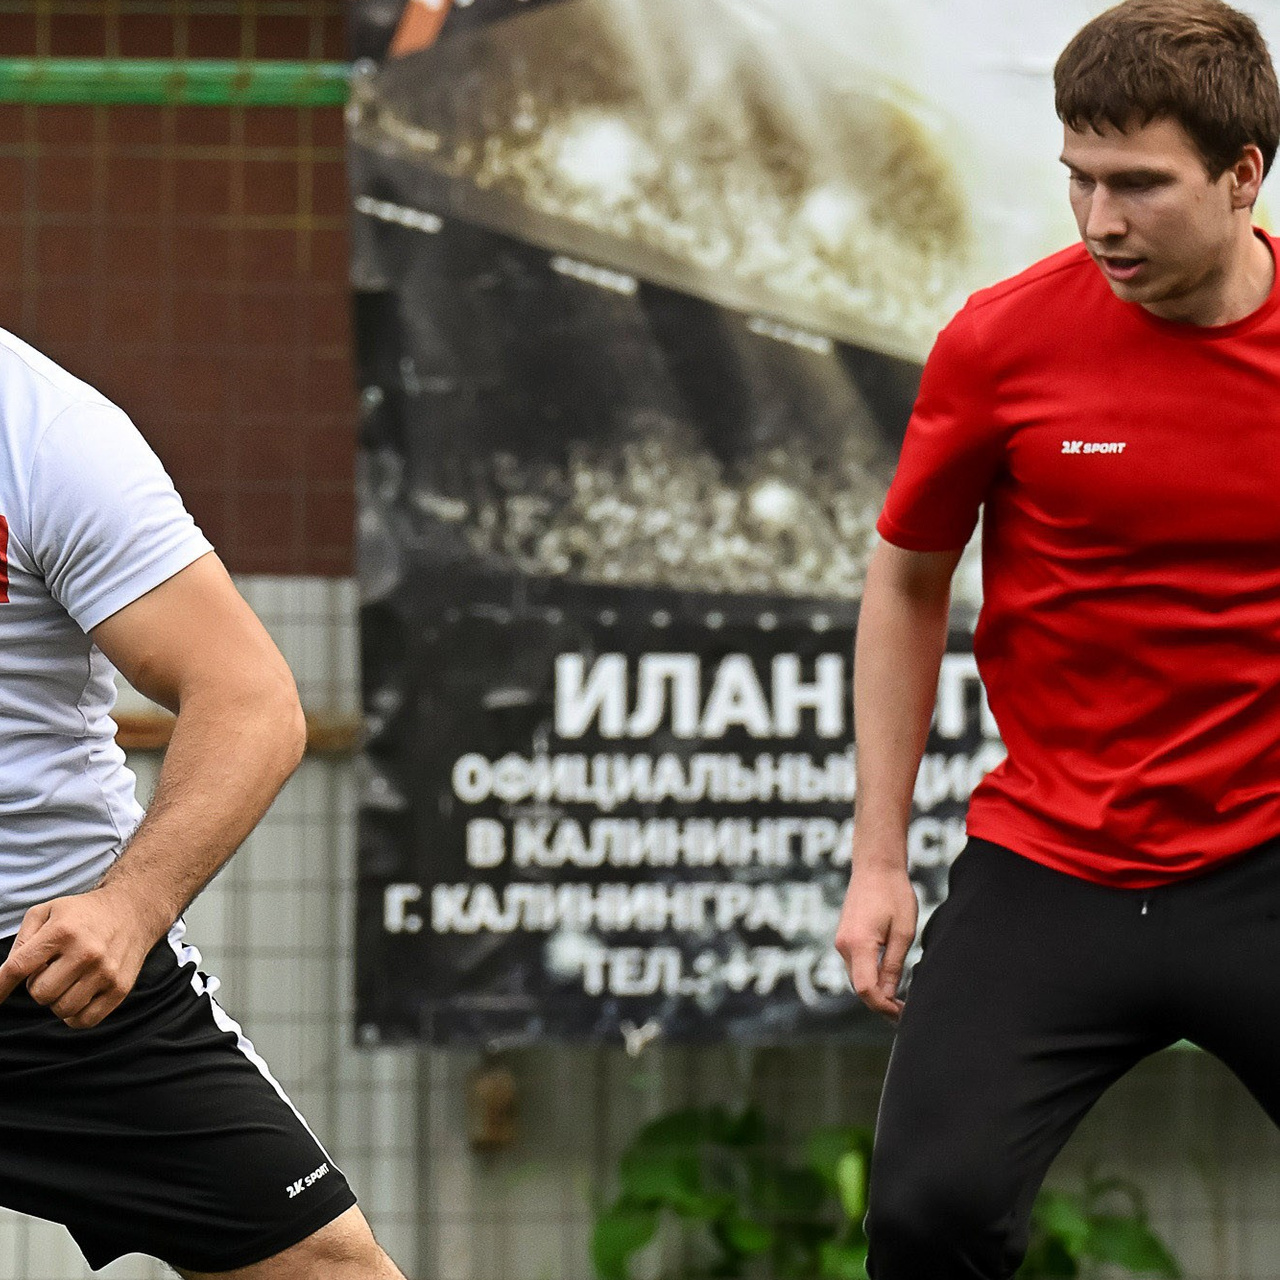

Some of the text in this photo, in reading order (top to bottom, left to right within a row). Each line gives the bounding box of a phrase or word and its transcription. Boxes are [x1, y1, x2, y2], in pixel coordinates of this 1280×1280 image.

[1083, 442, 1126, 454] SPORT
[466, 818, 508, 869] В
[383, 883, 422, 934] Г.
[305, 1162, 329, 1187] SPORT
